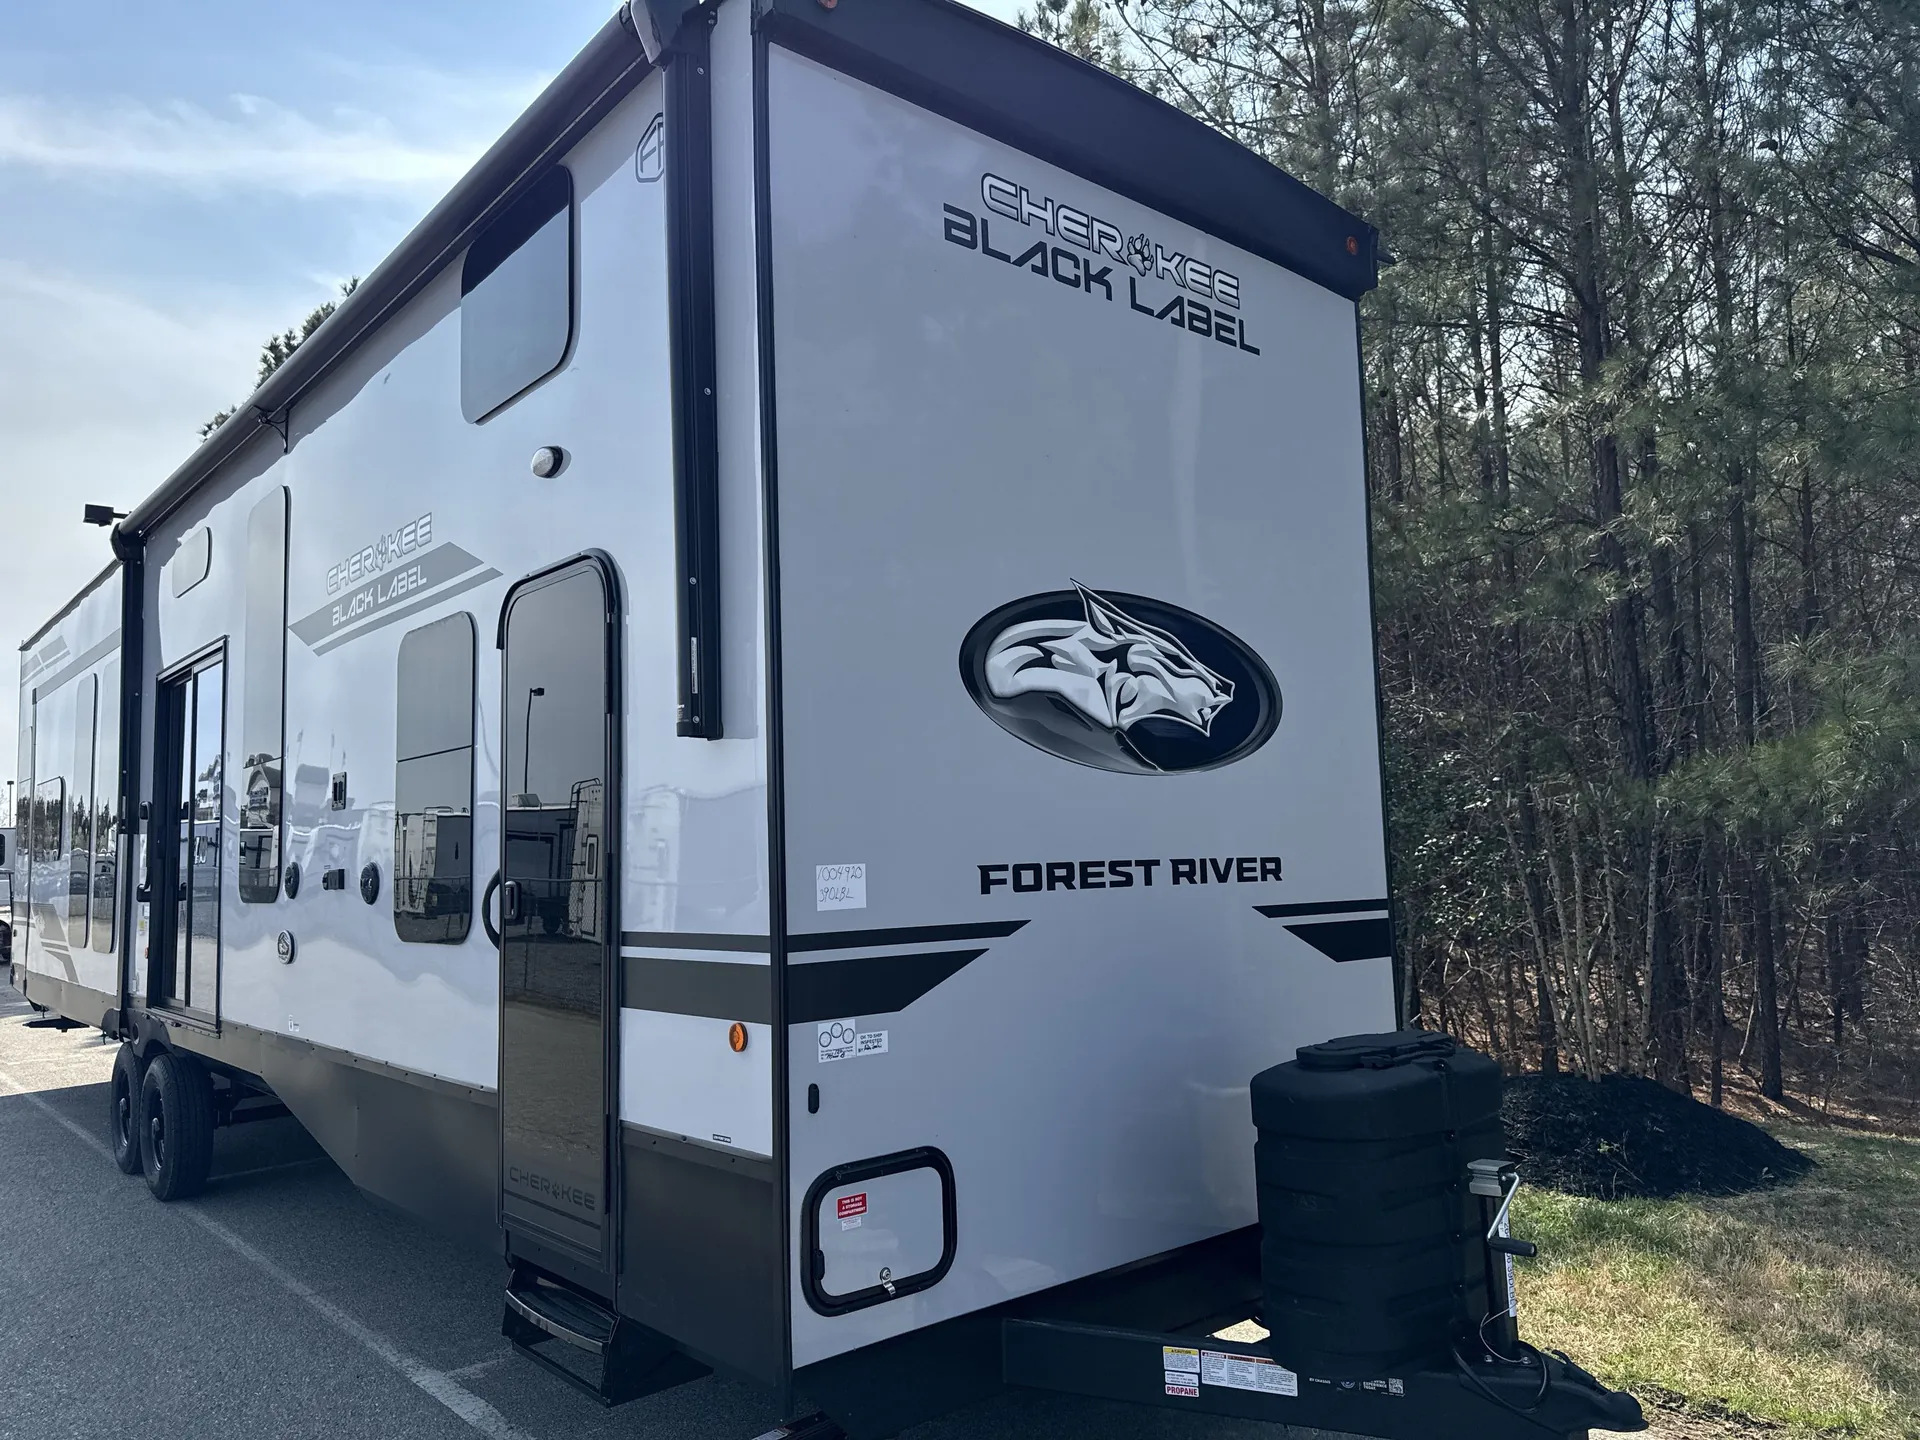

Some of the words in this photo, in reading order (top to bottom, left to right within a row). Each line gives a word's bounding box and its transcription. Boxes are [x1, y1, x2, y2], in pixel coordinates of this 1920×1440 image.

[943, 202, 1113, 301] BLACK
[1129, 276, 1260, 356] LABEL
[332, 588, 374, 626] BLACK
[378, 565, 427, 604] LABEL
[976, 859, 1161, 895] FOREST
[1168, 856, 1283, 885] RIVER
[1166, 1386, 1198, 1396] PROPANE
